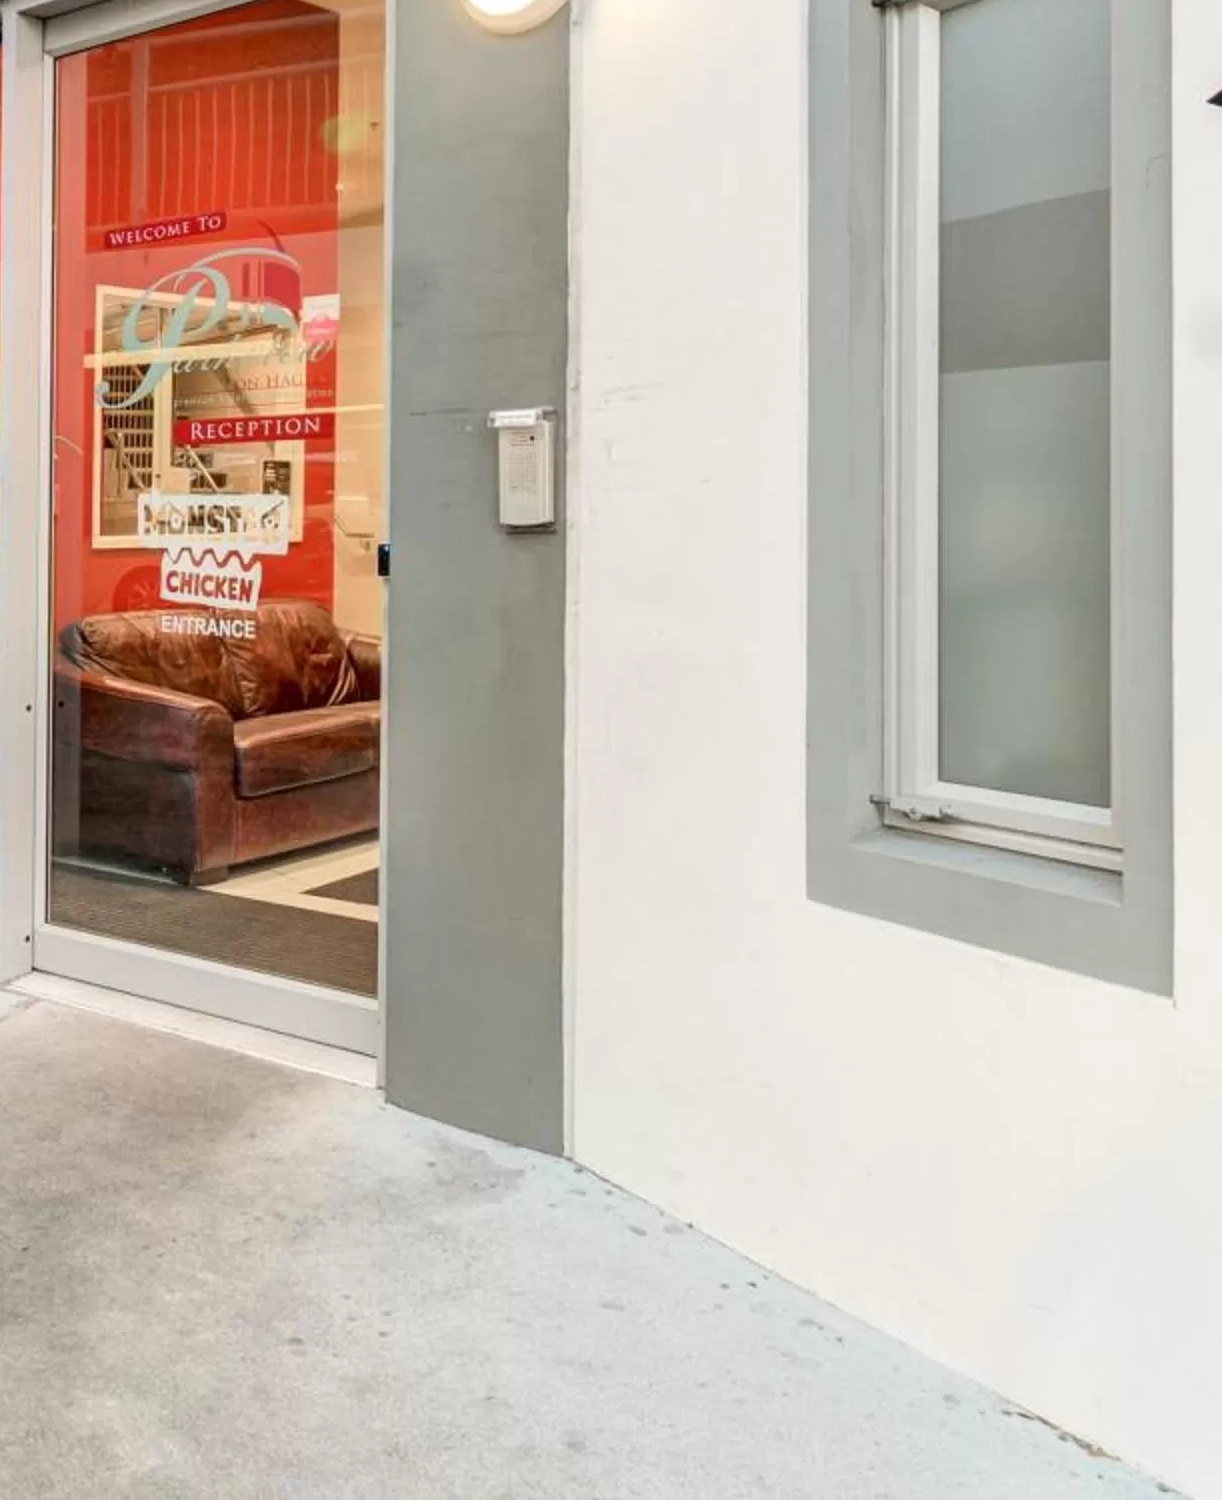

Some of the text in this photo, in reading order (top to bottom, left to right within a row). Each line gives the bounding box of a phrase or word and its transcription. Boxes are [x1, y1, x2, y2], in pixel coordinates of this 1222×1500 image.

[109, 215, 222, 245] WELCOME TO
[190, 417, 321, 441] RECEPTION
[166, 569, 254, 603] CHICKEN
[161, 615, 257, 638] ENTRANCE
